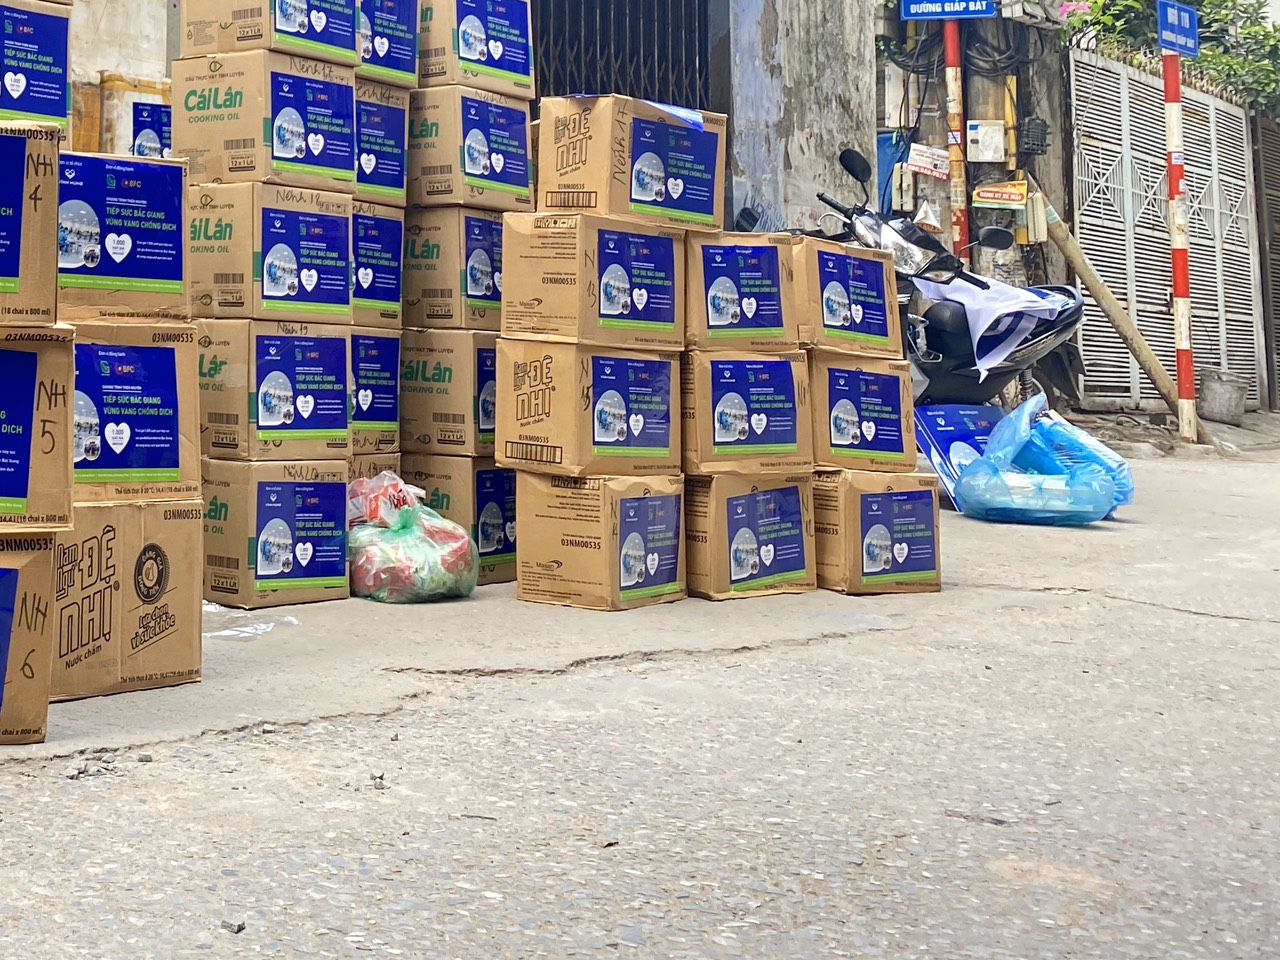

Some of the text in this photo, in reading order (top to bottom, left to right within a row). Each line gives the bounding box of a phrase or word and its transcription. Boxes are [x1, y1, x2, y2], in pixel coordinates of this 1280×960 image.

[910, 0, 942, 14] ĐƯỜNG
[41, 420, 59, 454] 5
[20, 649, 35, 679] 6
[65, 644, 102, 670] Nước chấm
